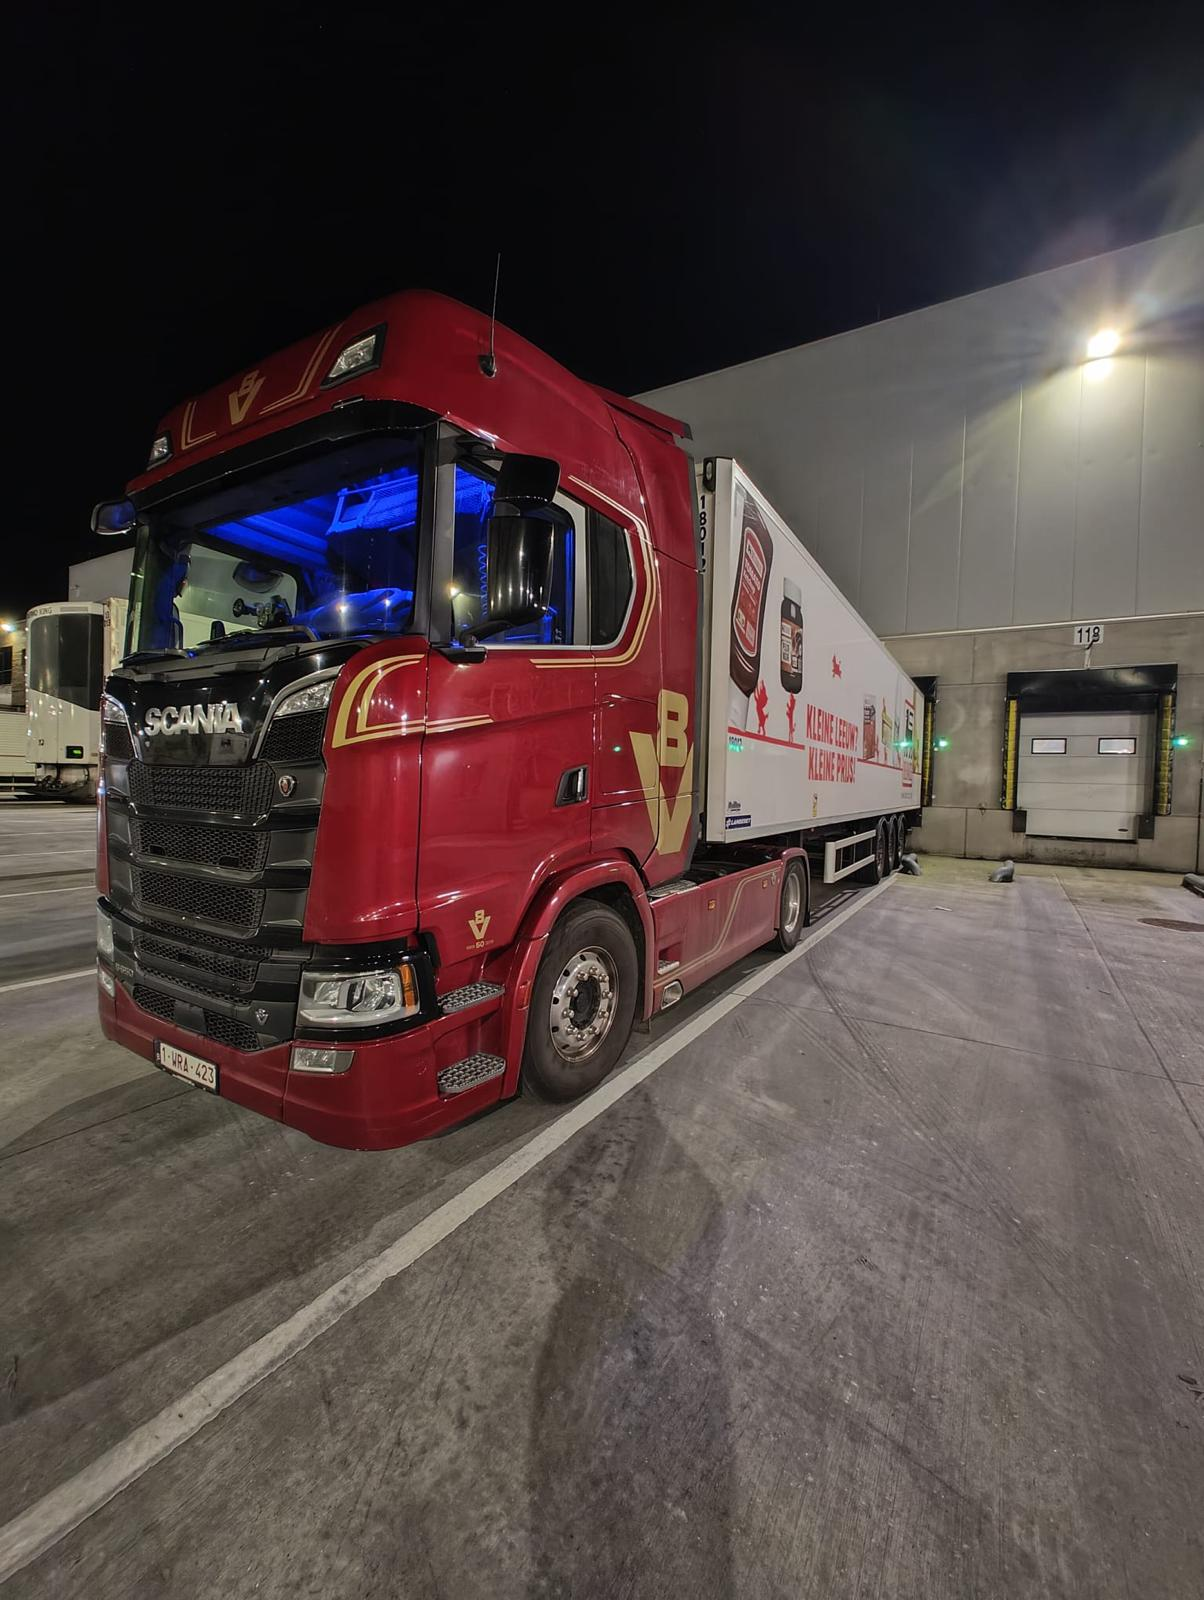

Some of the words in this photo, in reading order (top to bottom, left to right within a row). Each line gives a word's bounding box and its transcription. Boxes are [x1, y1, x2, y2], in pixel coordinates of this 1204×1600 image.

[1077, 626, 1100, 643] 118
[144, 702, 243, 736] SCANIA
[806, 703, 834, 745] KLEINE
[808, 746, 835, 782] KLEINE
[161, 1046, 214, 1084] 1-WRA-423
